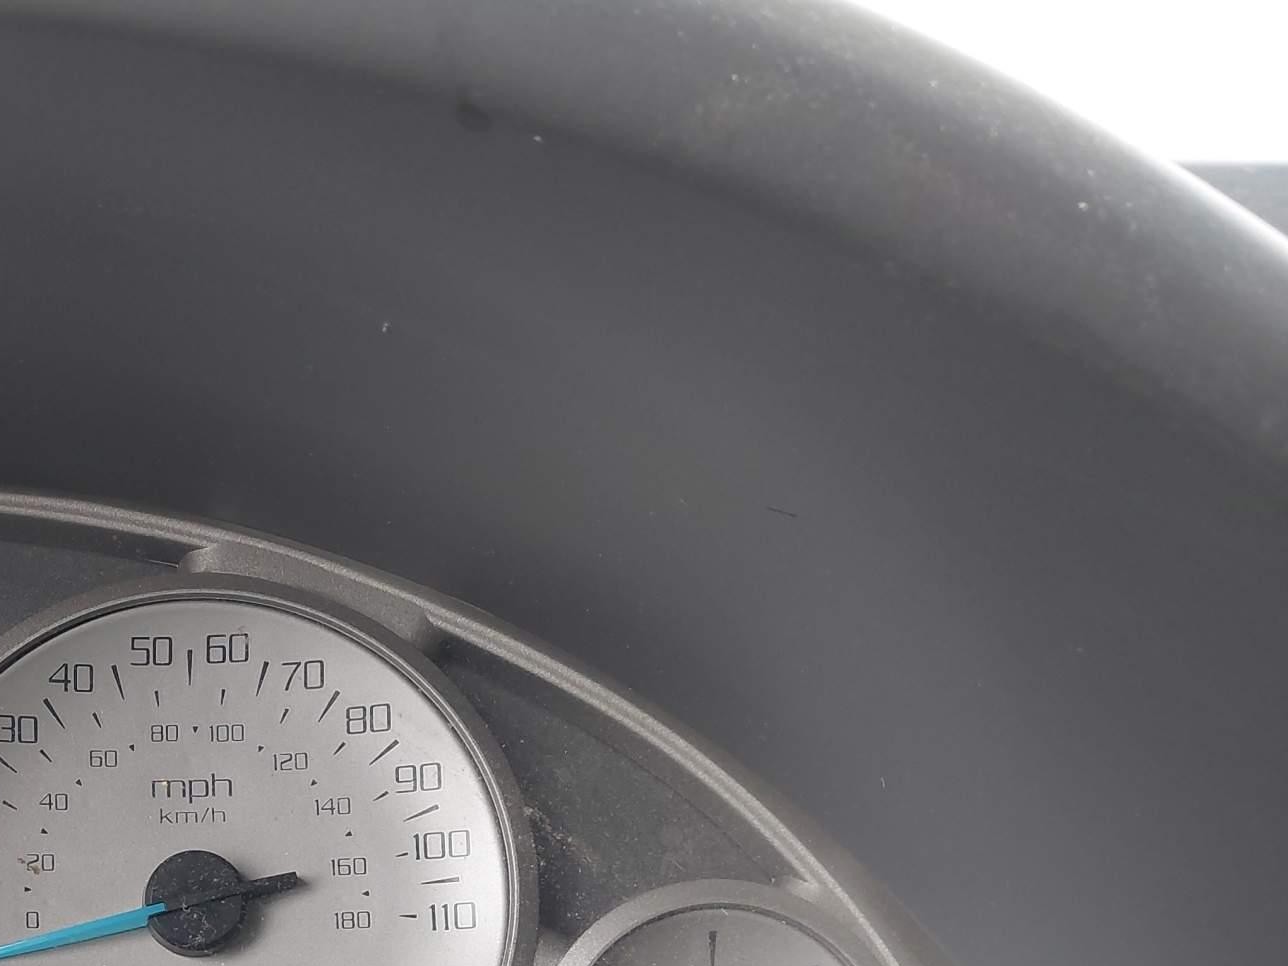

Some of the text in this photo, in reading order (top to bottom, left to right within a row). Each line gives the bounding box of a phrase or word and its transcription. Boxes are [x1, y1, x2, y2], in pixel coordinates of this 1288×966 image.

[131, 637, 172, 666] 50
[206, 633, 249, 664] 60
[49, 664, 93, 692] 40
[282, 660, 324, 691] 70
[346, 703, 391, 734] 80
[151, 725, 178, 742] 80
[209, 724, 244, 742] 100
[90, 750, 117, 767] 60
[274, 752, 308, 771] 120
[152, 773, 232, 801] mph
[395, 763, 441, 793] 90
[40, 794, 68, 810] 40
[315, 797, 351, 815] 140
[160, 808, 225, 823] km/h
[413, 830, 470, 860] 100
[27, 854, 54, 874] 20
[331, 858, 366, 875] 160
[26, 912, 39, 928] 0
[335, 911, 370, 929] 180
[429, 903, 476, 931] 110
